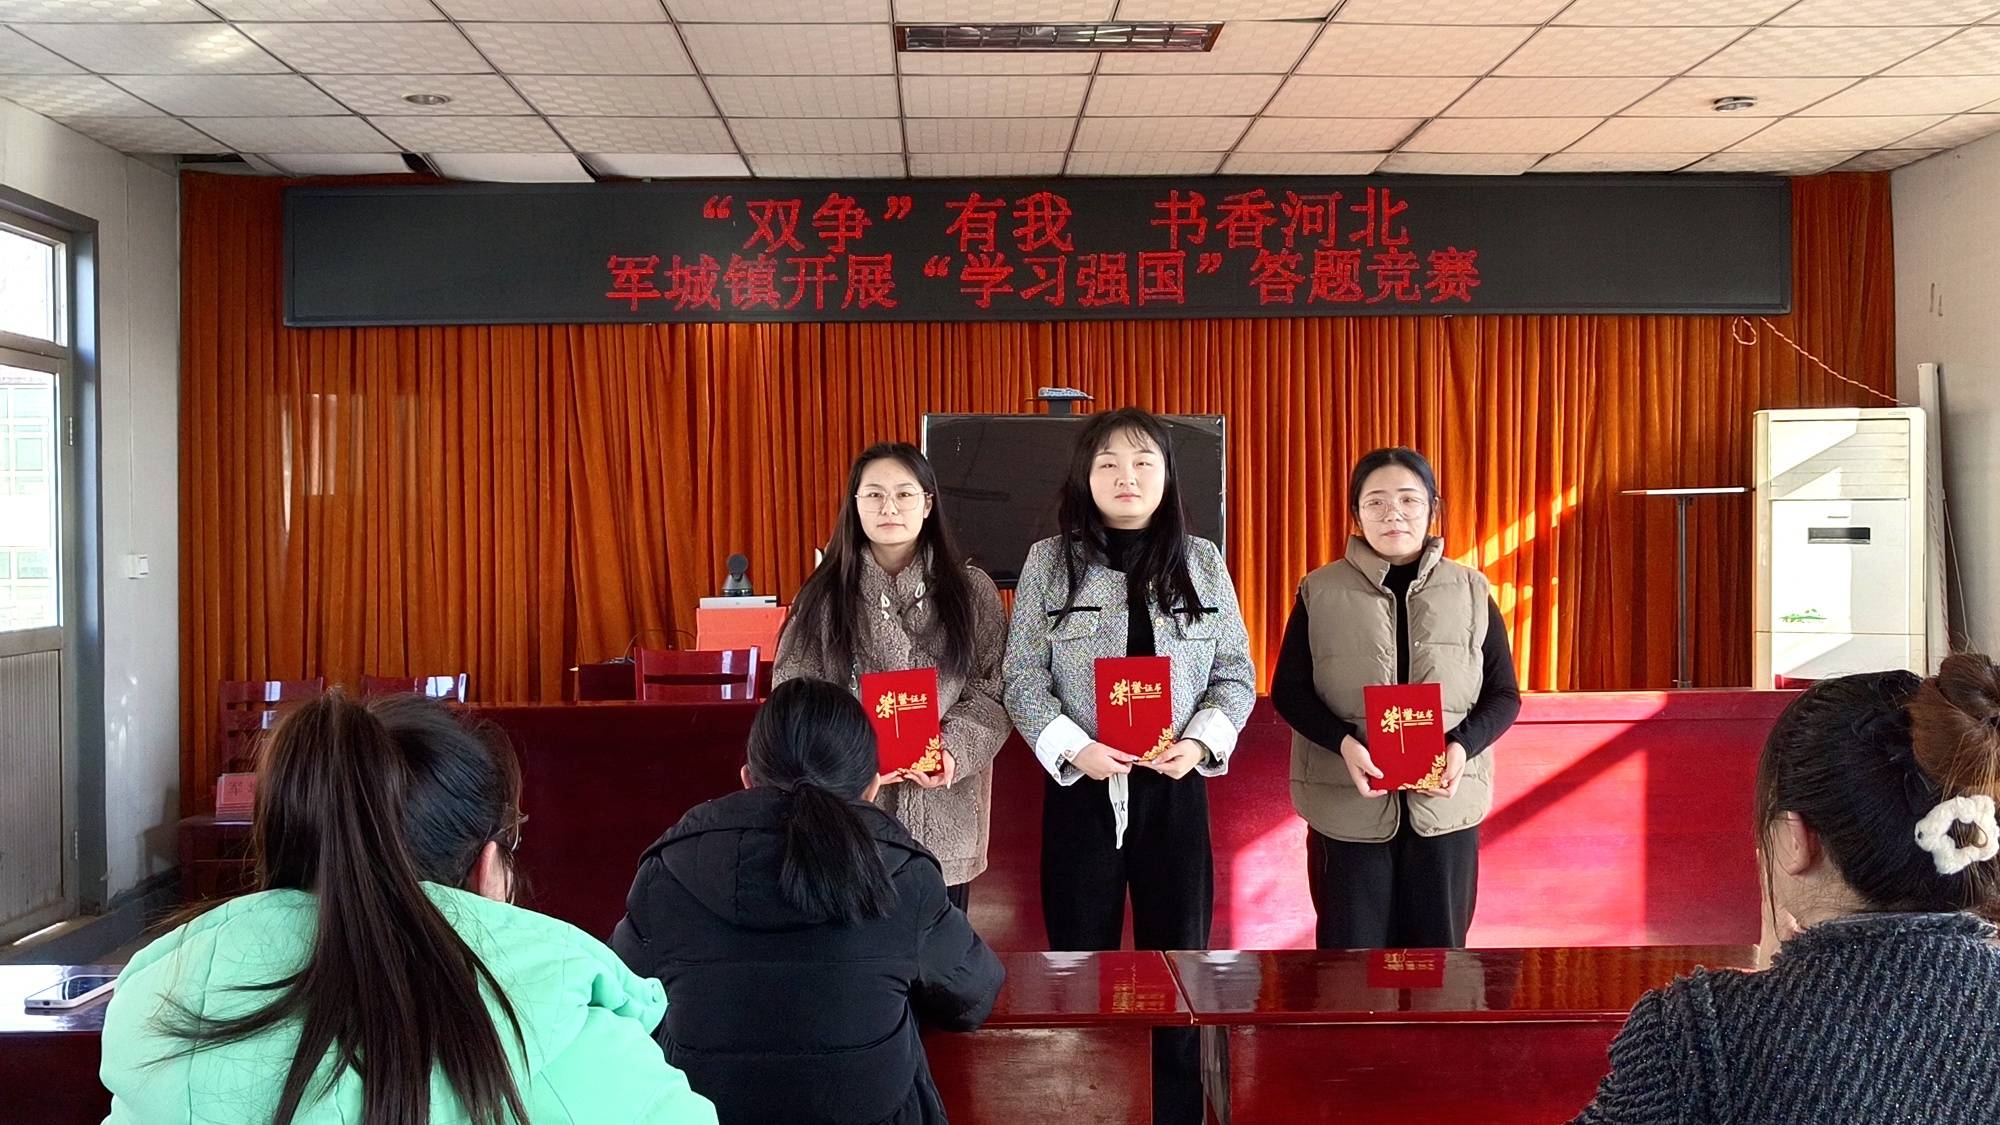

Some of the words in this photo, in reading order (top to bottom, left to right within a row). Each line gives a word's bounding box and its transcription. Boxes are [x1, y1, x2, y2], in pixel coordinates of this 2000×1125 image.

[1151, 187, 1410, 249] 书香河北
[606, 247, 1482, 311] 军城镇开展“学习强国”答题竞赛
